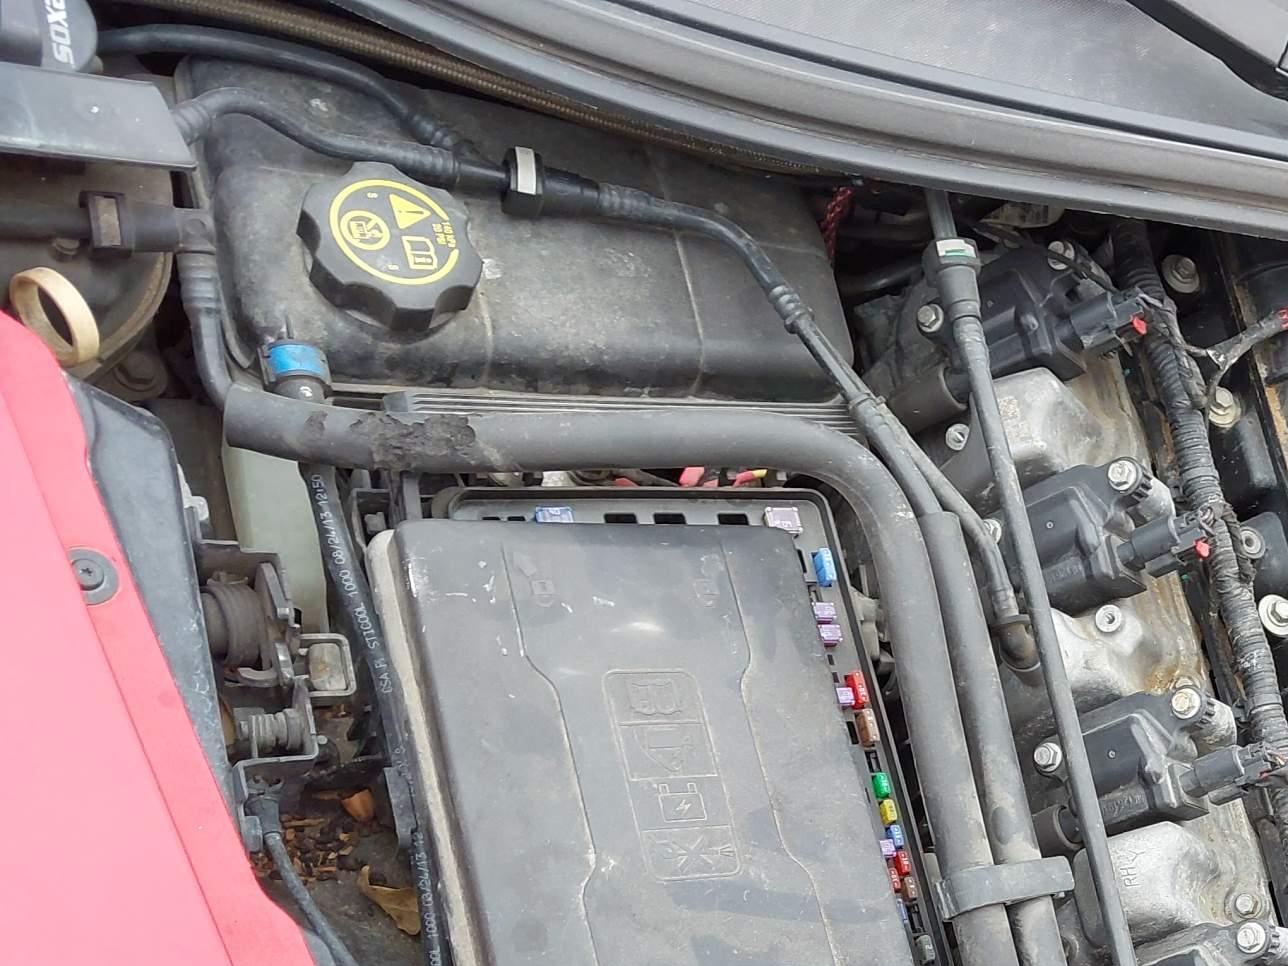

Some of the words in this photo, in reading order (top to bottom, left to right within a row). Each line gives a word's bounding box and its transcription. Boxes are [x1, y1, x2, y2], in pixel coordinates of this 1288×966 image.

[311, 474, 328, 507] 12:50
[319, 511, 344, 565] 08/24/13
[339, 569, 358, 598] 1000
[424, 912, 439, 938] 1000
